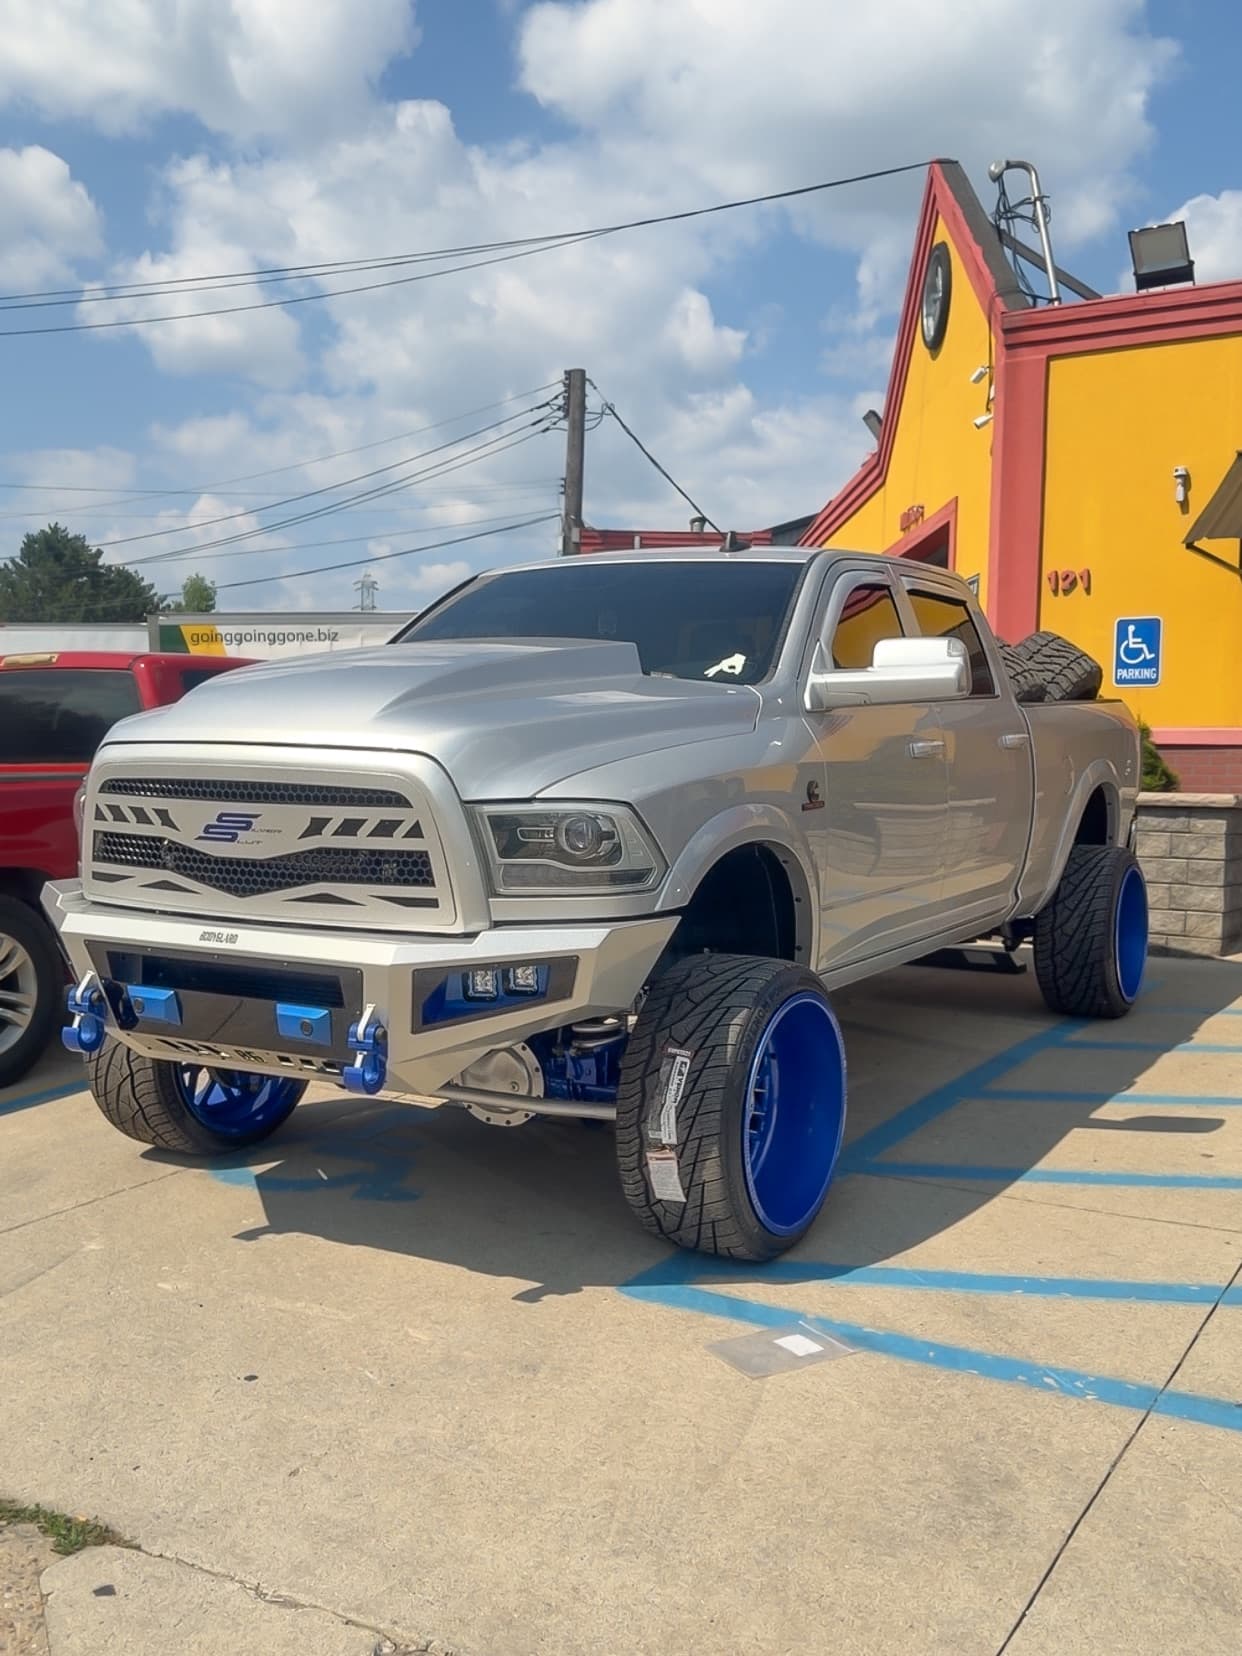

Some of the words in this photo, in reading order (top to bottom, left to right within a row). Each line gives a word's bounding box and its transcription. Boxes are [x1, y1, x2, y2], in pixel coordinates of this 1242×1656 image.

[1047, 568, 1090, 596] 121
[190, 628, 339, 646] goinggoinggone.biz
[1117, 668, 1156, 680] PARKING
